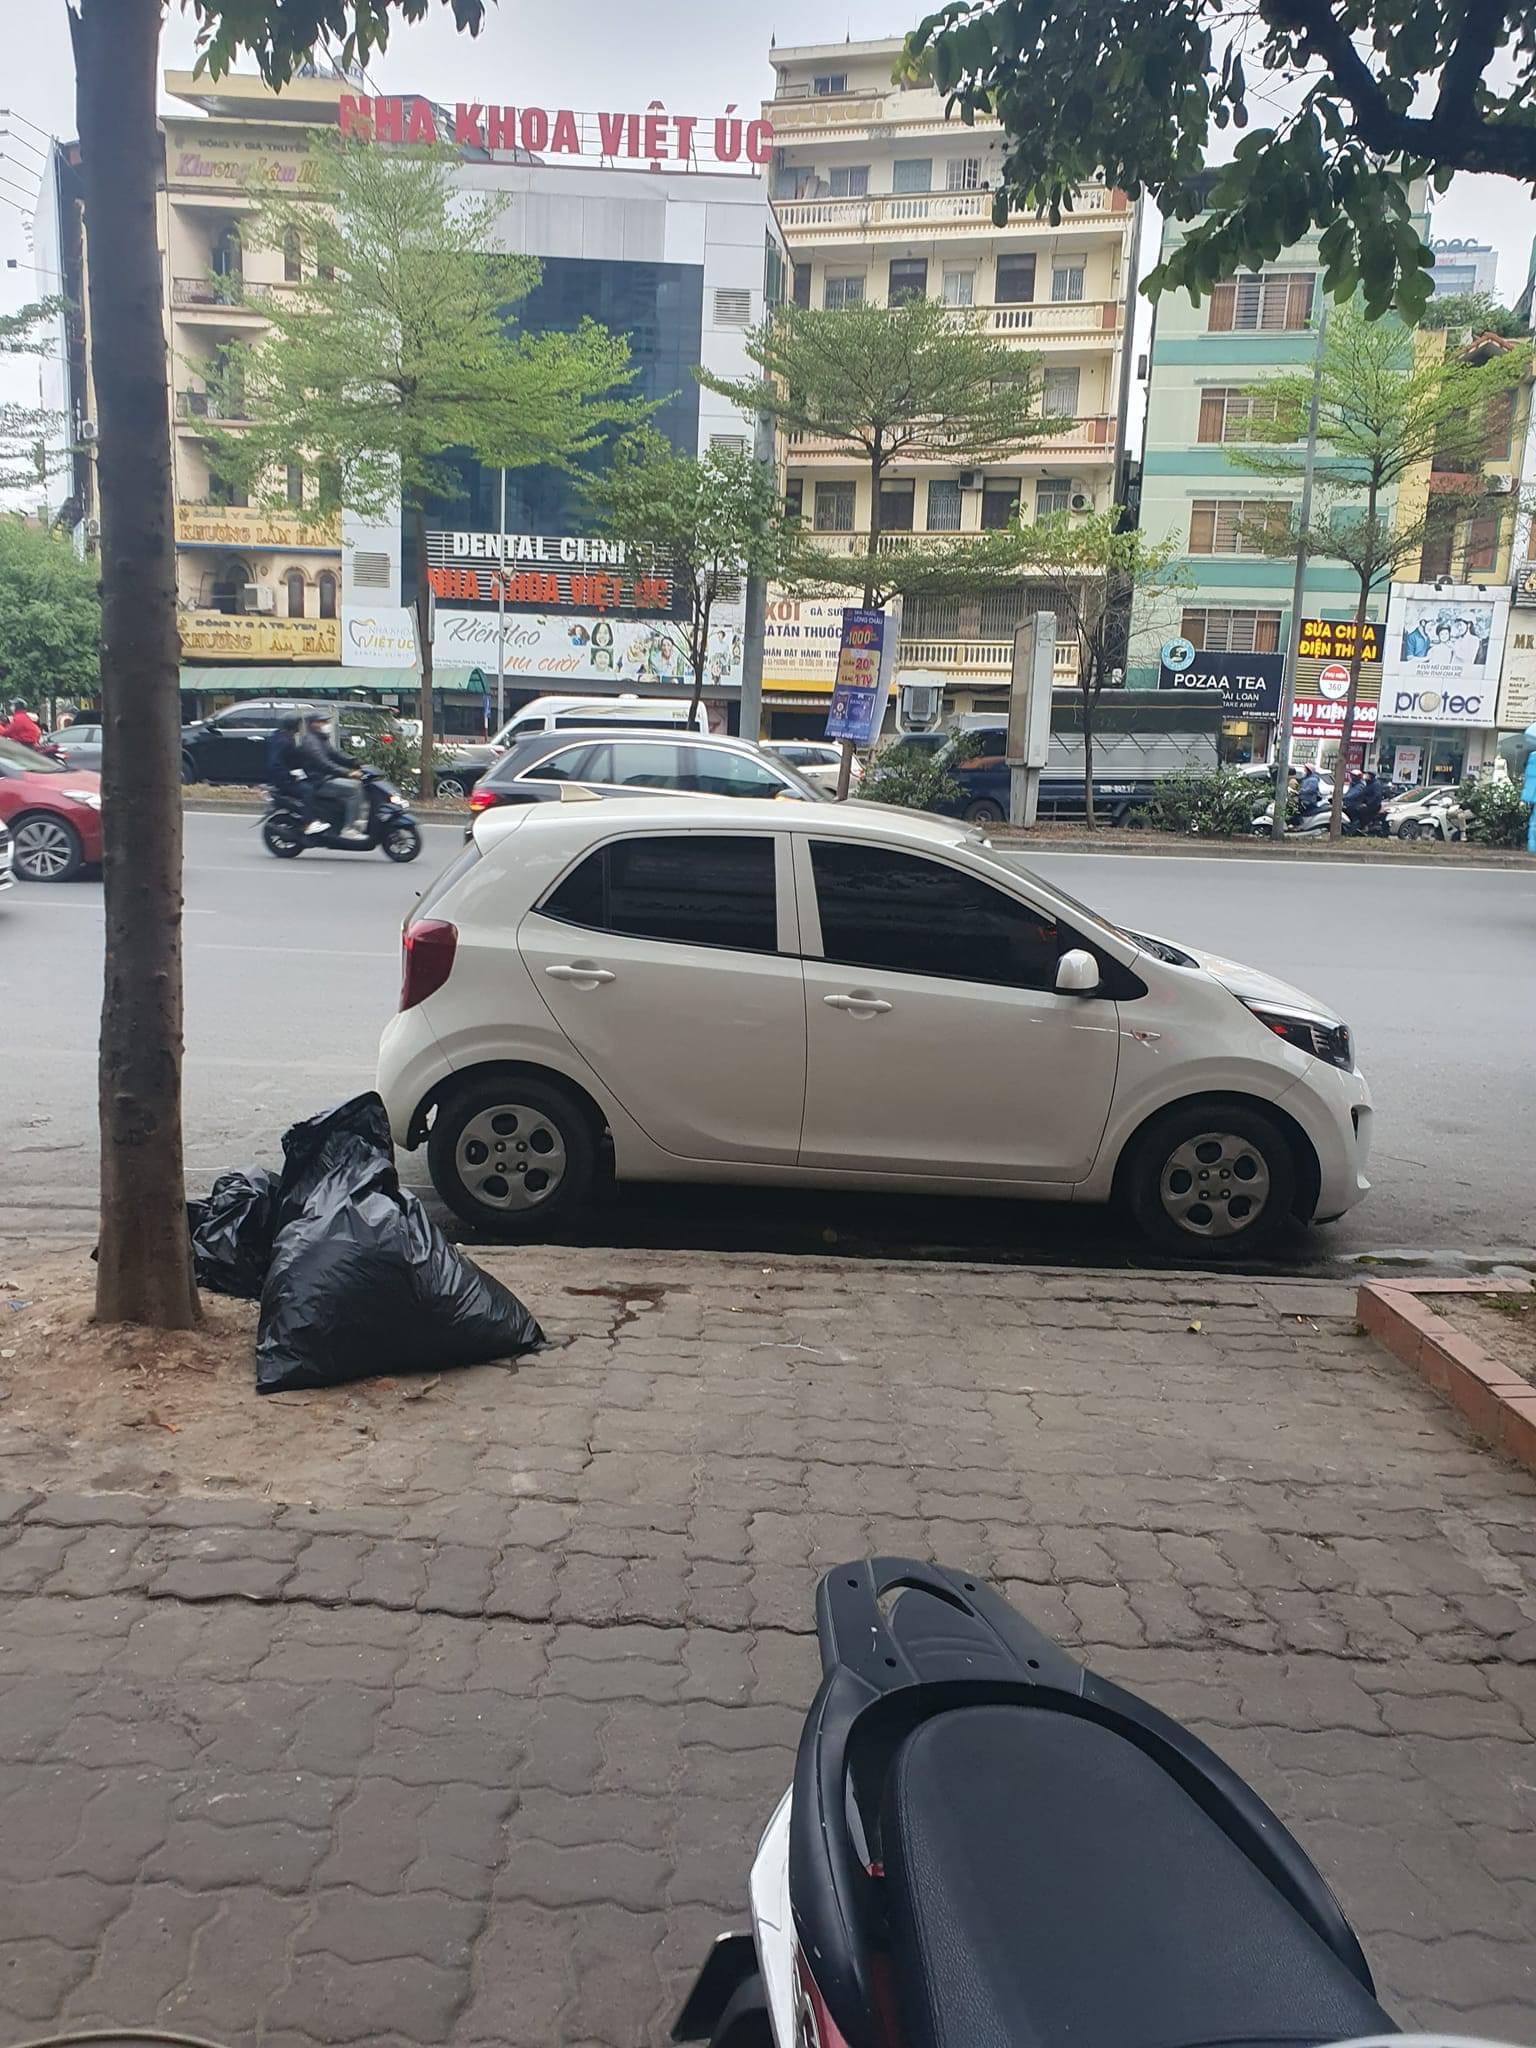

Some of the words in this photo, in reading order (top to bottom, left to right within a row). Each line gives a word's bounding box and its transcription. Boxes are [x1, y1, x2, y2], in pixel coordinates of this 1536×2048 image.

[340, 94, 437, 145] NHA
[456, 102, 584, 156] KHOA
[598, 100, 698, 173] VIỆT
[714, 104, 774, 163] ÚC
[453, 533, 549, 561] DENTAL
[560, 537, 630, 564] CLINI
[427, 567, 480, 599] NHA
[1304, 618, 1332, 638] SỬA
[1299, 639, 1331, 659] ĐIỆN
[1174, 673, 1230, 689] POZAA
[1235, 676, 1266, 690] TEA
[1237, 693, 1259, 701] LOAN
